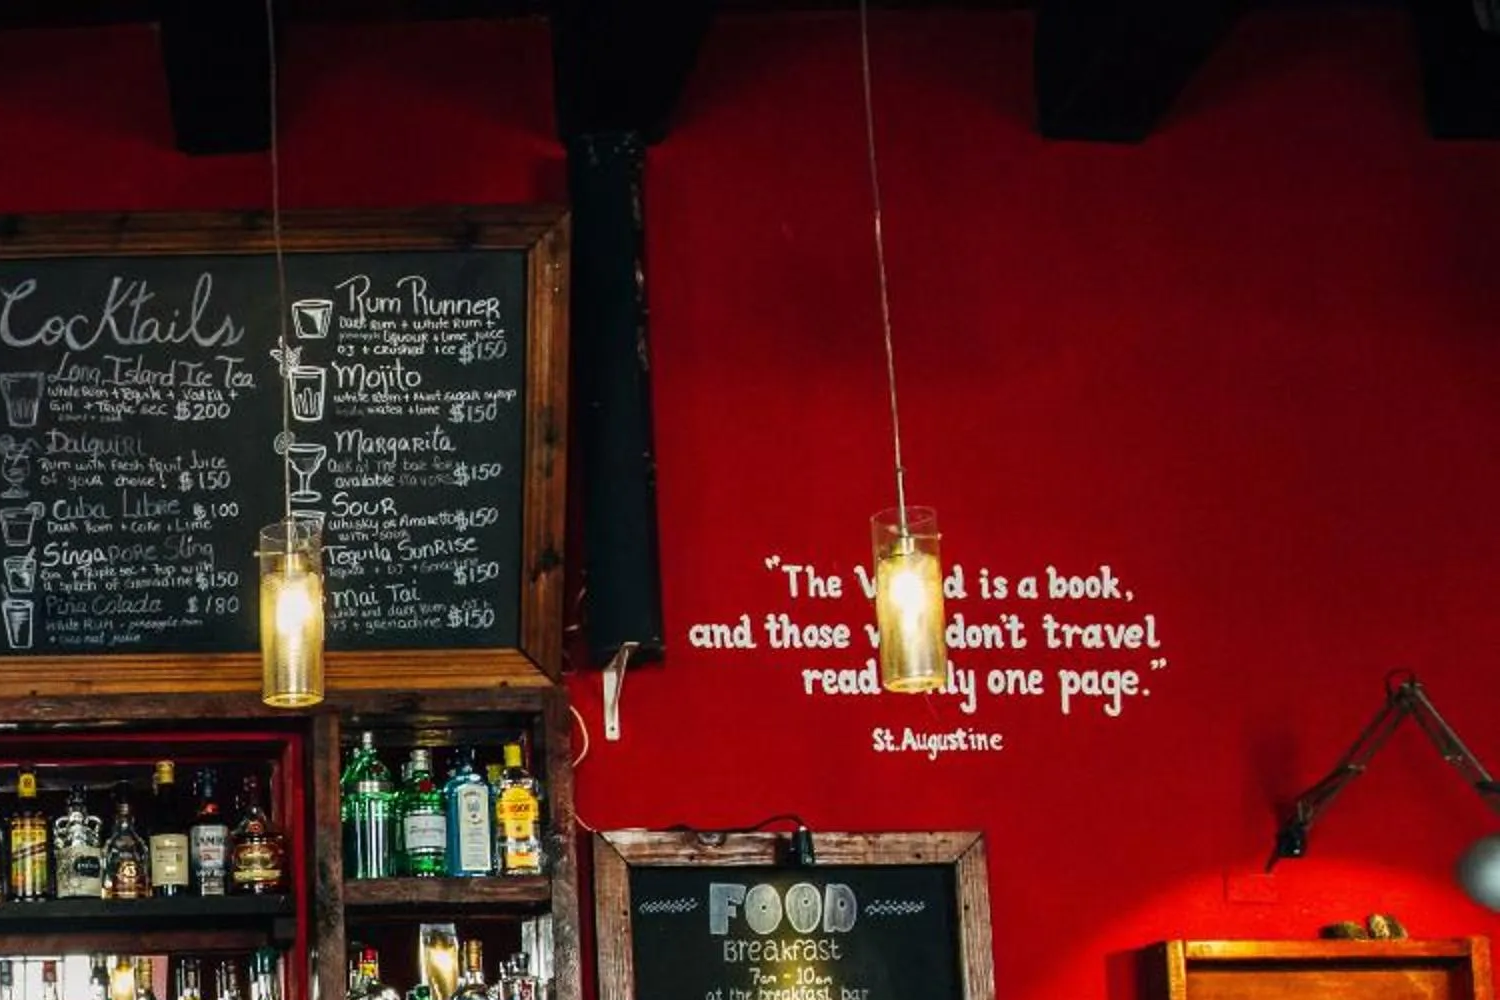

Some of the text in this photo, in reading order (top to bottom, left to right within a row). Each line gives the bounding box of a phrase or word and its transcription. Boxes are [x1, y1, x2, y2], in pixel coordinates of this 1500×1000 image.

[334, 274, 401, 321] Rum
[457, 340, 509, 365] $150
[102, 353, 175, 386] Island
[213, 354, 257, 389] Tea
[331, 357, 422, 395] Mojito
[173, 401, 232, 422] $200
[448, 400, 498, 424] $150
[333, 424, 457, 462] Margarita
[177, 470, 232, 493] $150
[452, 460, 502, 487] $150
[51, 496, 112, 521] Cuba
[192, 501, 240, 521] $100
[450, 507, 499, 532] $150
[322, 543, 392, 571] Tequila
[196, 571, 240, 591] $150
[451, 560, 500, 586] $150
[978, 566, 1009, 599] is
[1016, 573, 1039, 599] a
[1045, 565, 1134, 602] book,
[385, 579, 421, 602] Tai
[186, 595, 241, 615] $180
[446, 606, 496, 629] $150
[688, 613, 757, 650] and
[764, 613, 852, 650] those
[945, 612, 1028, 650] don't
[1042, 613, 1161, 650] travel
[802, 658, 881, 696] read
[987, 669, 1045, 696] one
[708, 881, 858, 935] FOOD
[723, 937, 844, 963] Breakfast
